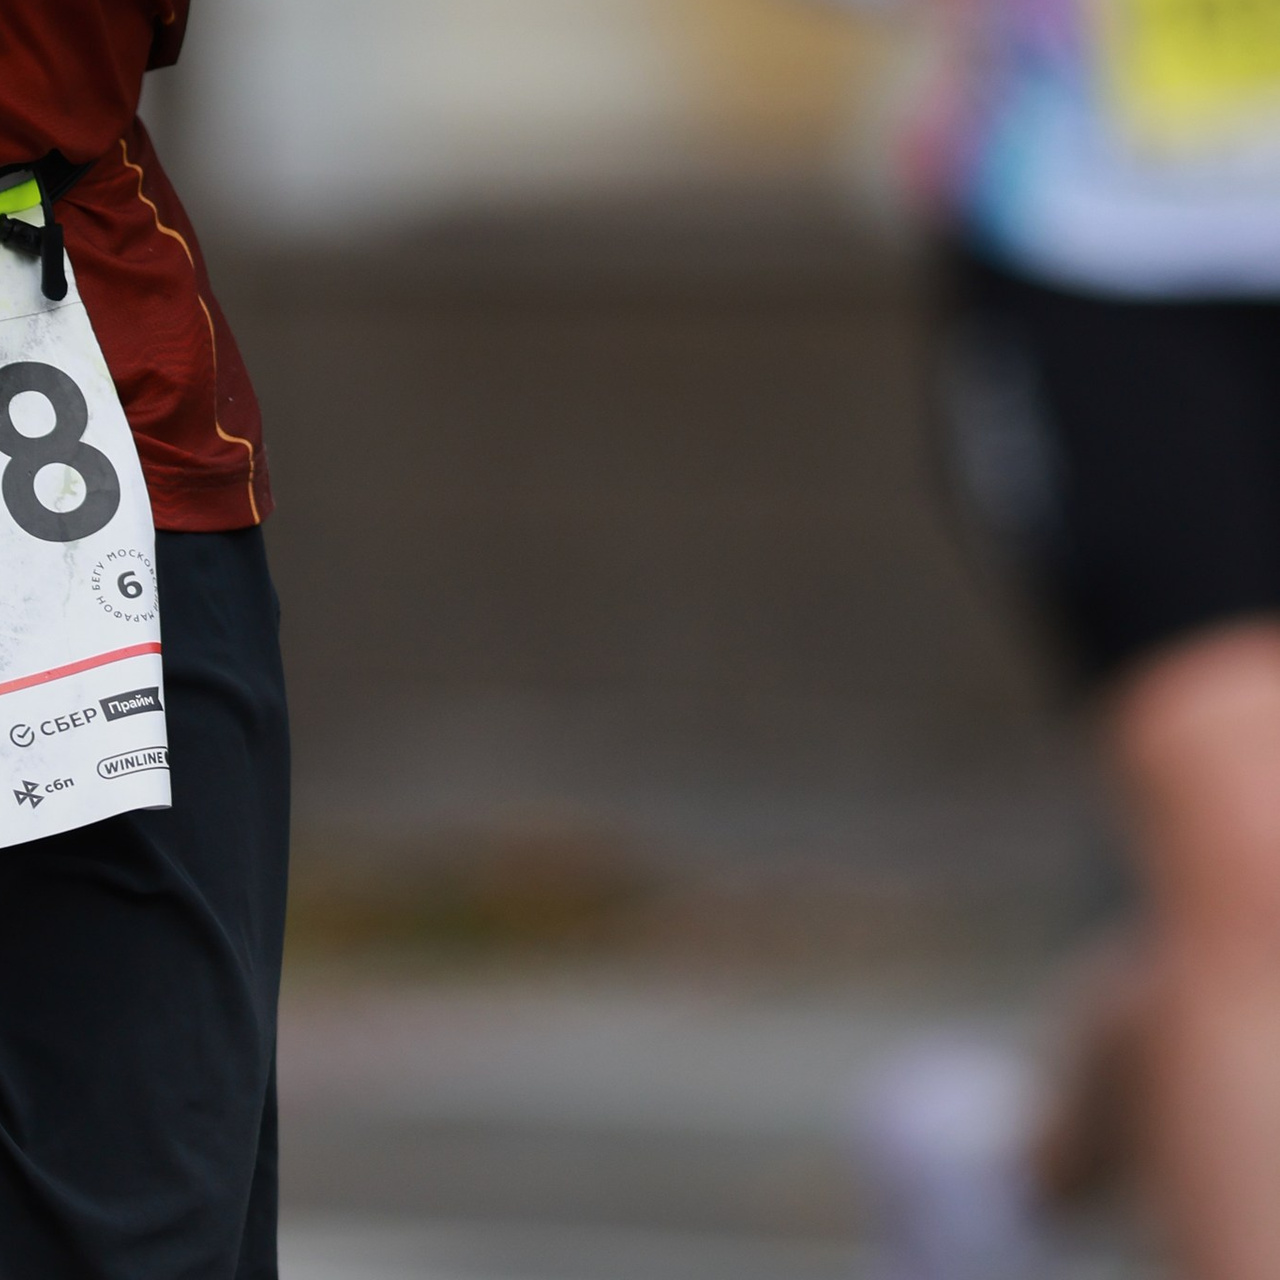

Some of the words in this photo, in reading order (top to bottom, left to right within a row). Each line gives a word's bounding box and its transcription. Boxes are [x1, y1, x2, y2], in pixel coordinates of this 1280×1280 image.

[91, 561, 105, 591] БЕГУ
[116, 570, 143, 599] 6
[39, 707, 98, 737] СБЕР
[108, 694, 156, 715] Прайм
[104, 750, 164, 776] WINLINE
[45, 777, 75, 795] сбп
